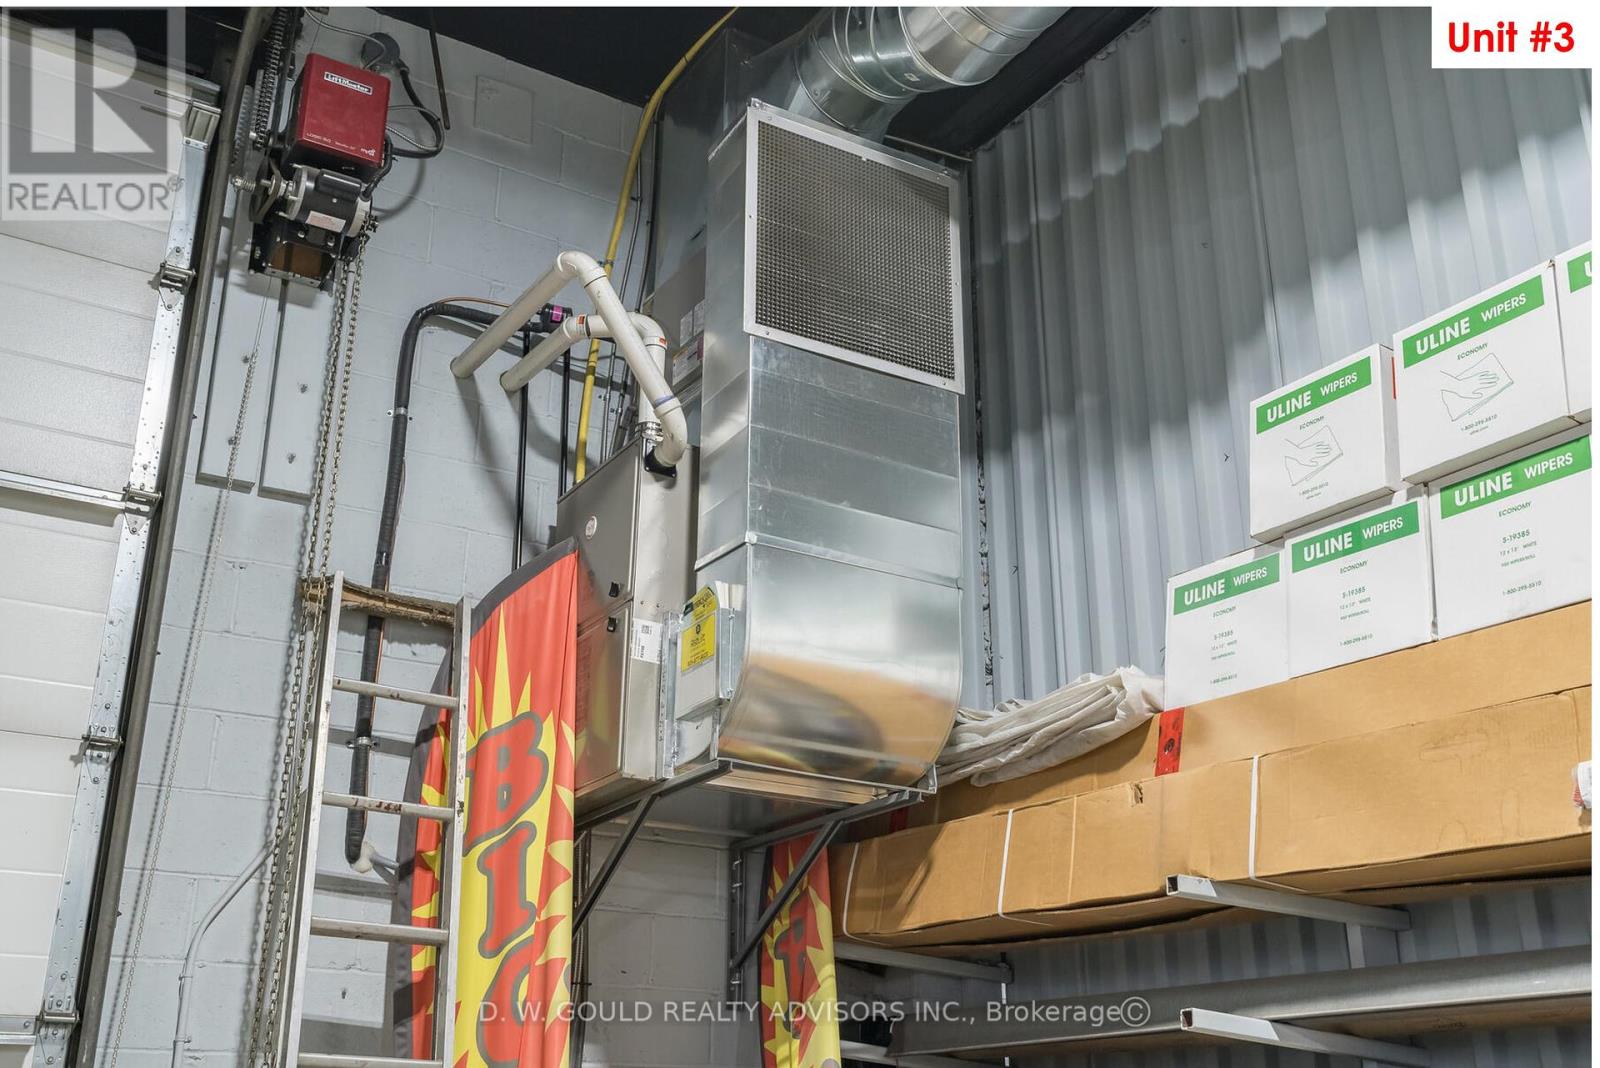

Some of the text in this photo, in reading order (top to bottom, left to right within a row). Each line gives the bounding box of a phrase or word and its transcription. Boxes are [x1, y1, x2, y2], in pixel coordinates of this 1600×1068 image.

[1416, 293, 1527, 355] ULINE WIPERS
[1457, 342, 1489, 360] ECONOMY
[1266, 372, 1358, 423] ULINE WIPERS
[1299, 415, 1325, 430] ECONOMY
[1454, 452, 1574, 507] ULINE WIPERS
[1498, 501, 1532, 518] ECONOMY
[1303, 516, 1404, 562] ULINE WIPERS
[1339, 559, 1369, 575] ECONOMY
[1184, 567, 1268, 606] ULINE WIPERS
[1212, 606, 1237, 618] ECONOMY
